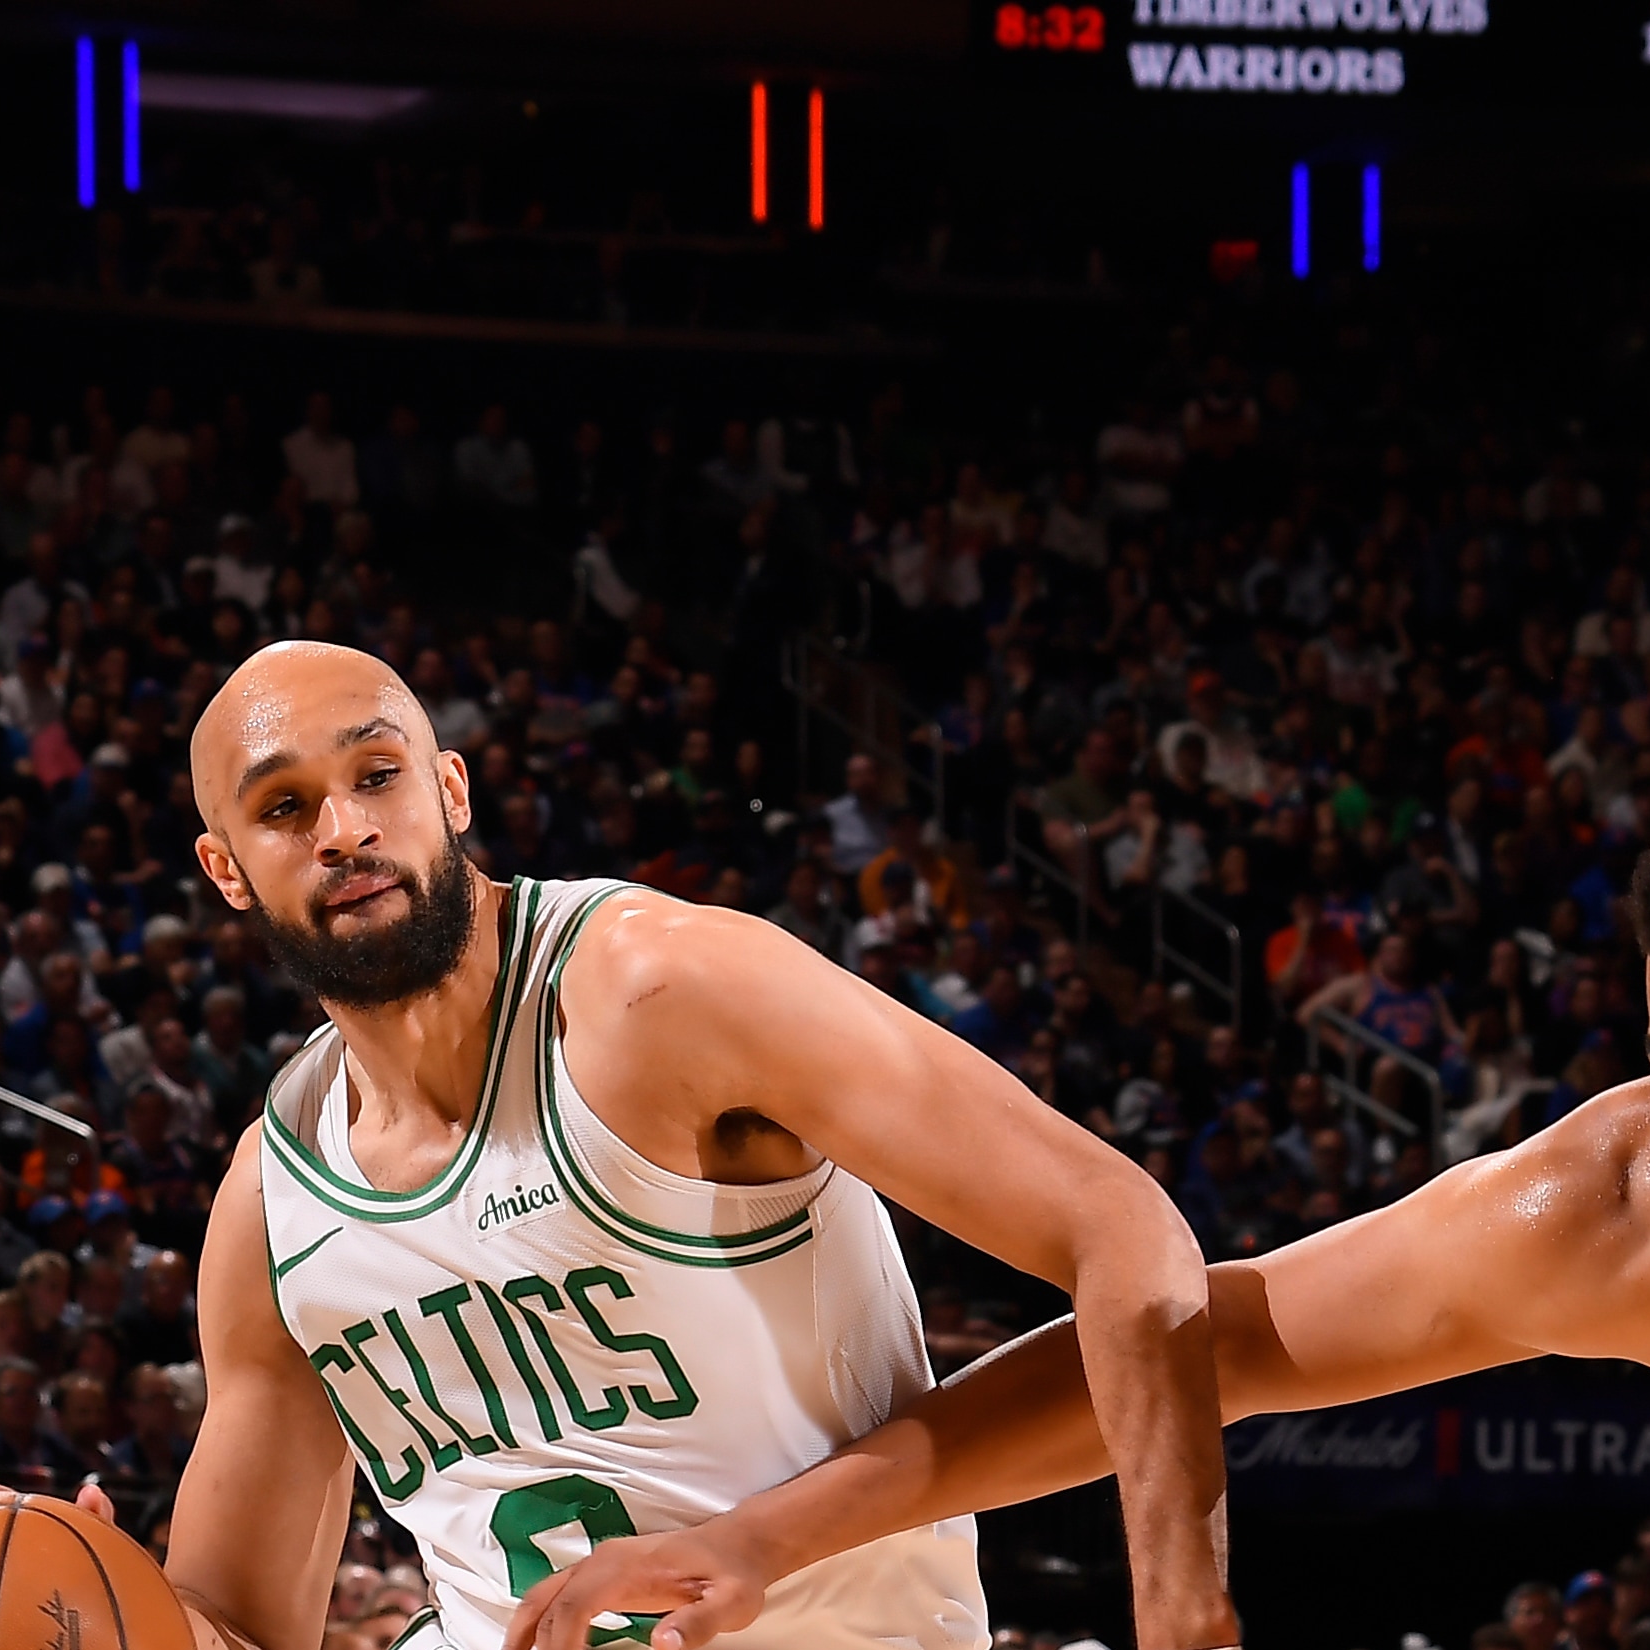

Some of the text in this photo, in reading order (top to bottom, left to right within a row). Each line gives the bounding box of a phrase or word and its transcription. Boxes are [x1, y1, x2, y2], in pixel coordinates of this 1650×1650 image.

[1128, 42, 1405, 93] WARRIORS
[478, 1182, 560, 1231] Amica
[309, 1265, 700, 1501] CELTICS
